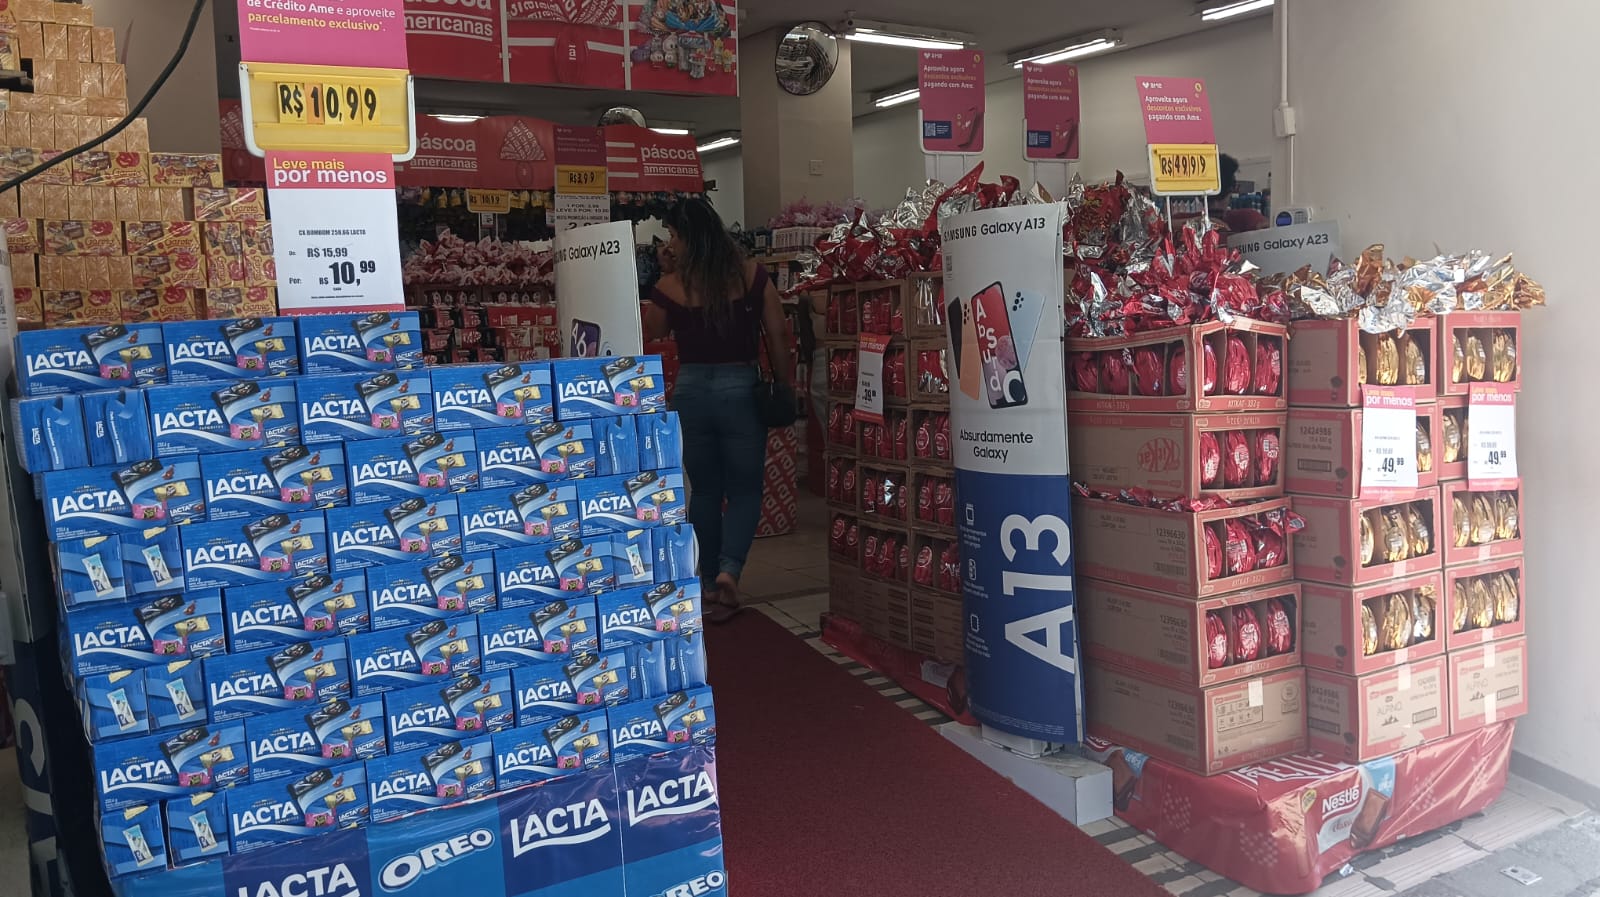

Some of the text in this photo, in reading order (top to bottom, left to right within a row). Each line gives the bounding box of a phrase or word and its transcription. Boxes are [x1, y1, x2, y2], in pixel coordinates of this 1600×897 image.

[248, 13, 326, 28] parcelamento
[308, 4, 334, 14] Ame
[346, 7, 396, 18] aproveite
[404, 15, 494, 37] mericanas
[273, 158, 345, 170] Leve mais
[410, 156, 478, 171] americanas
[641, 144, 696, 164] páscoa
[274, 169, 387, 186] por menos
[643, 164, 699, 176] americanas
[980, 220, 1023, 236] Galaxy
[1024, 217, 1046, 231] A13
[322, 248, 348, 258] 15,99
[568, 244, 598, 260] Galaxy
[599, 239, 621, 256] A23
[1263, 233, 1329, 250] Galaxy A23
[169, 341, 230, 365] LACTA
[304, 335, 360, 357] LACTA
[26, 350, 93, 377] LACTA
[435, 389, 491, 412] LACTA
[559, 379, 610, 403] LACTA
[1366, 395, 1413, 406] por menos
[1471, 392, 1512, 402] por menos
[154, 409, 223, 437] LACTA
[302, 399, 365, 425] LACTA
[960, 430, 1033, 444] Absurdamente
[480, 446, 536, 472] LACTA
[973, 445, 1008, 463] Galaxy
[352, 459, 412, 486] LACTA
[207, 474, 274, 503] LACTA
[52, 489, 125, 522] LACTA
[581, 496, 631, 520] LACTA
[463, 509, 519, 536] LACTA
[332, 525, 394, 553] LACTA
[186, 542, 253, 572] LACTA
[500, 566, 554, 592] LACTA
[372, 583, 432, 611] LACTA
[1000, 514, 1075, 674] A13
[232, 604, 297, 634] LACTA
[602, 608, 651, 634] LACTA
[74, 625, 146, 656] LACTA
[482, 628, 539, 655] LACTA
[355, 650, 416, 680] LACTA
[211, 675, 278, 705] LACTA
[518, 683, 572, 710] LACTA
[391, 709, 449, 736] LACTA
[612, 720, 662, 748] LACTA
[251, 732, 315, 763] LACTA
[499, 747, 552, 775] LACTA
[101, 760, 171, 793] LACTA
[371, 773, 430, 805] LACTA
[627, 771, 716, 827] LACTA
[233, 802, 298, 836] LACTA
[510, 798, 611, 858] LACTA
[380, 828, 493, 888] OREO
[649, 872, 724, 897] REO
